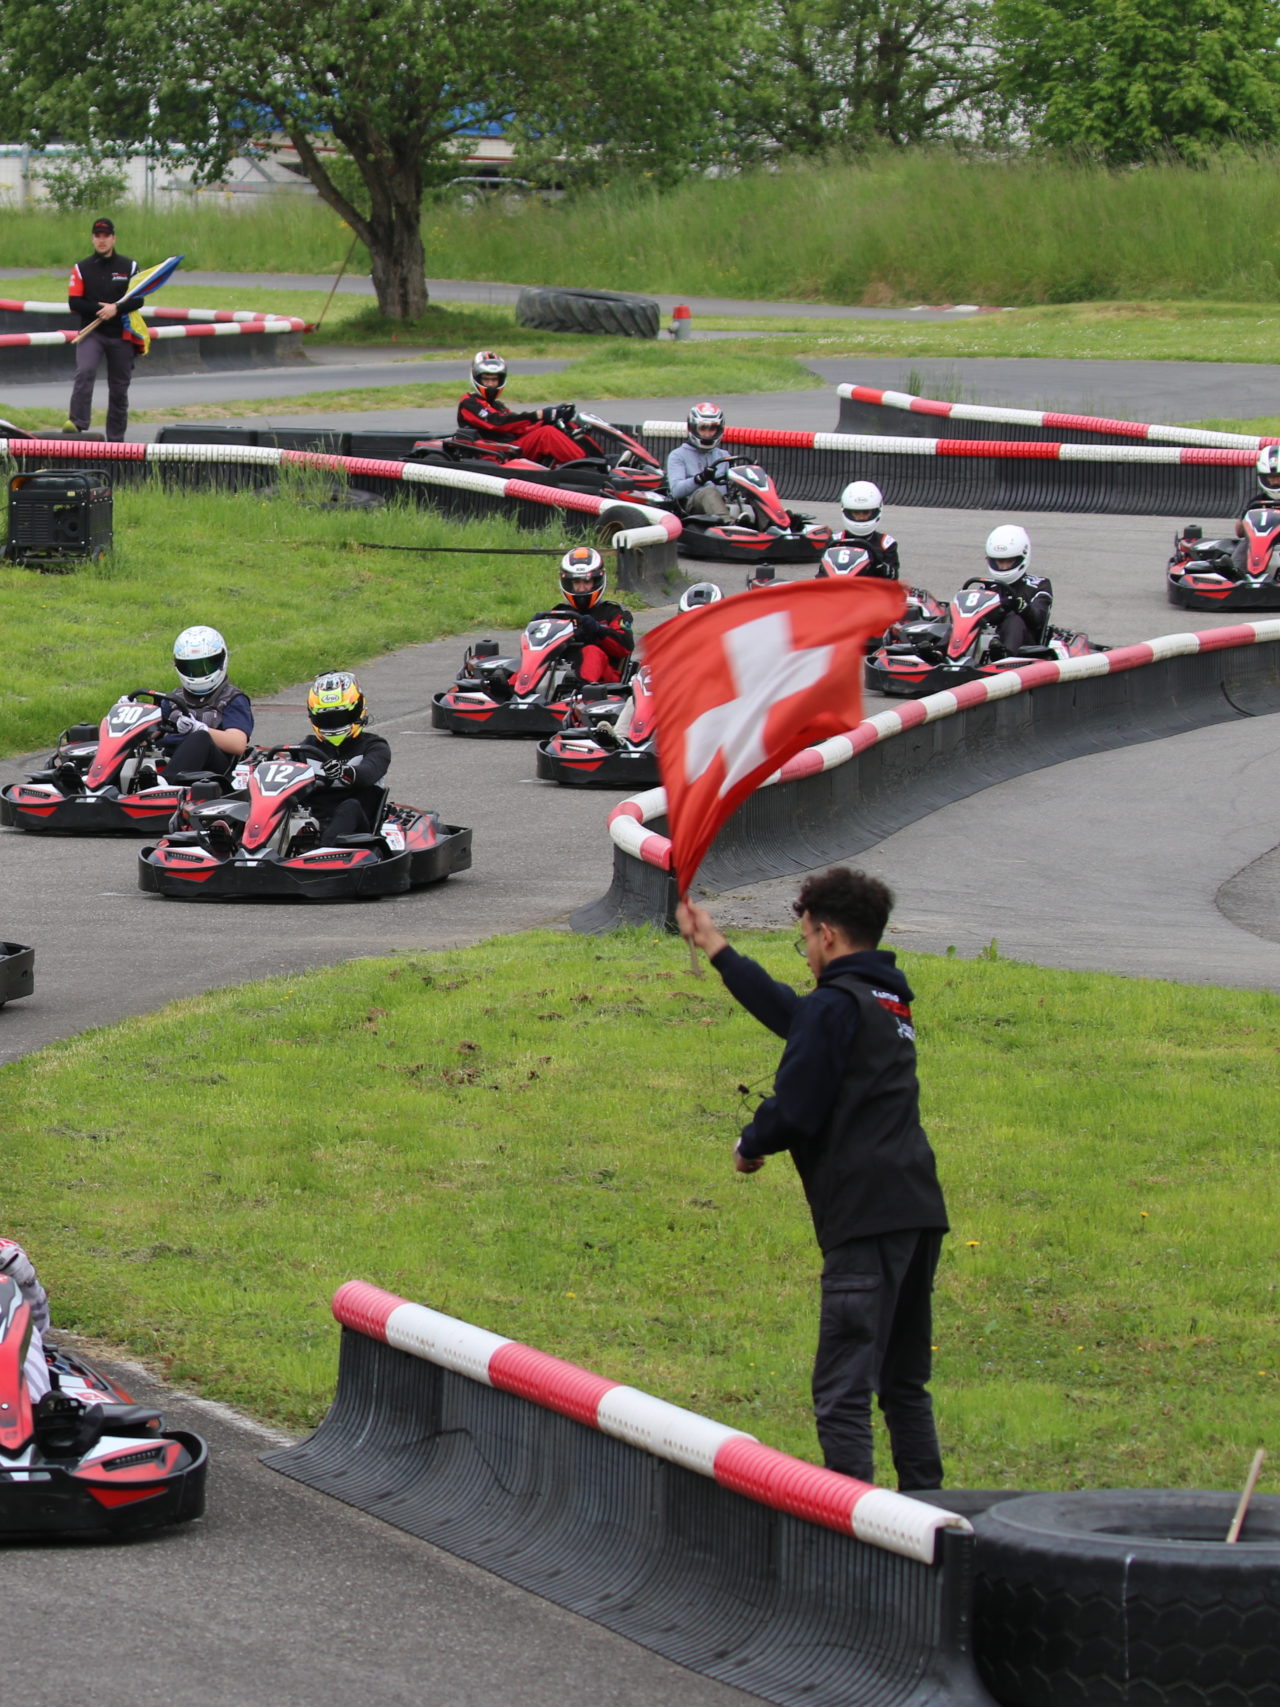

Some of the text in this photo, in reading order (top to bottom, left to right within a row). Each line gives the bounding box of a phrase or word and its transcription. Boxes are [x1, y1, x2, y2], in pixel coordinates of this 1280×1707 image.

[746, 467, 761, 481] 4
[838, 549, 850, 564] 6
[965, 592, 981, 607] 8
[535, 622, 552, 639] 3
[111, 706, 144, 724] 30
[264, 764, 294, 783] 12
